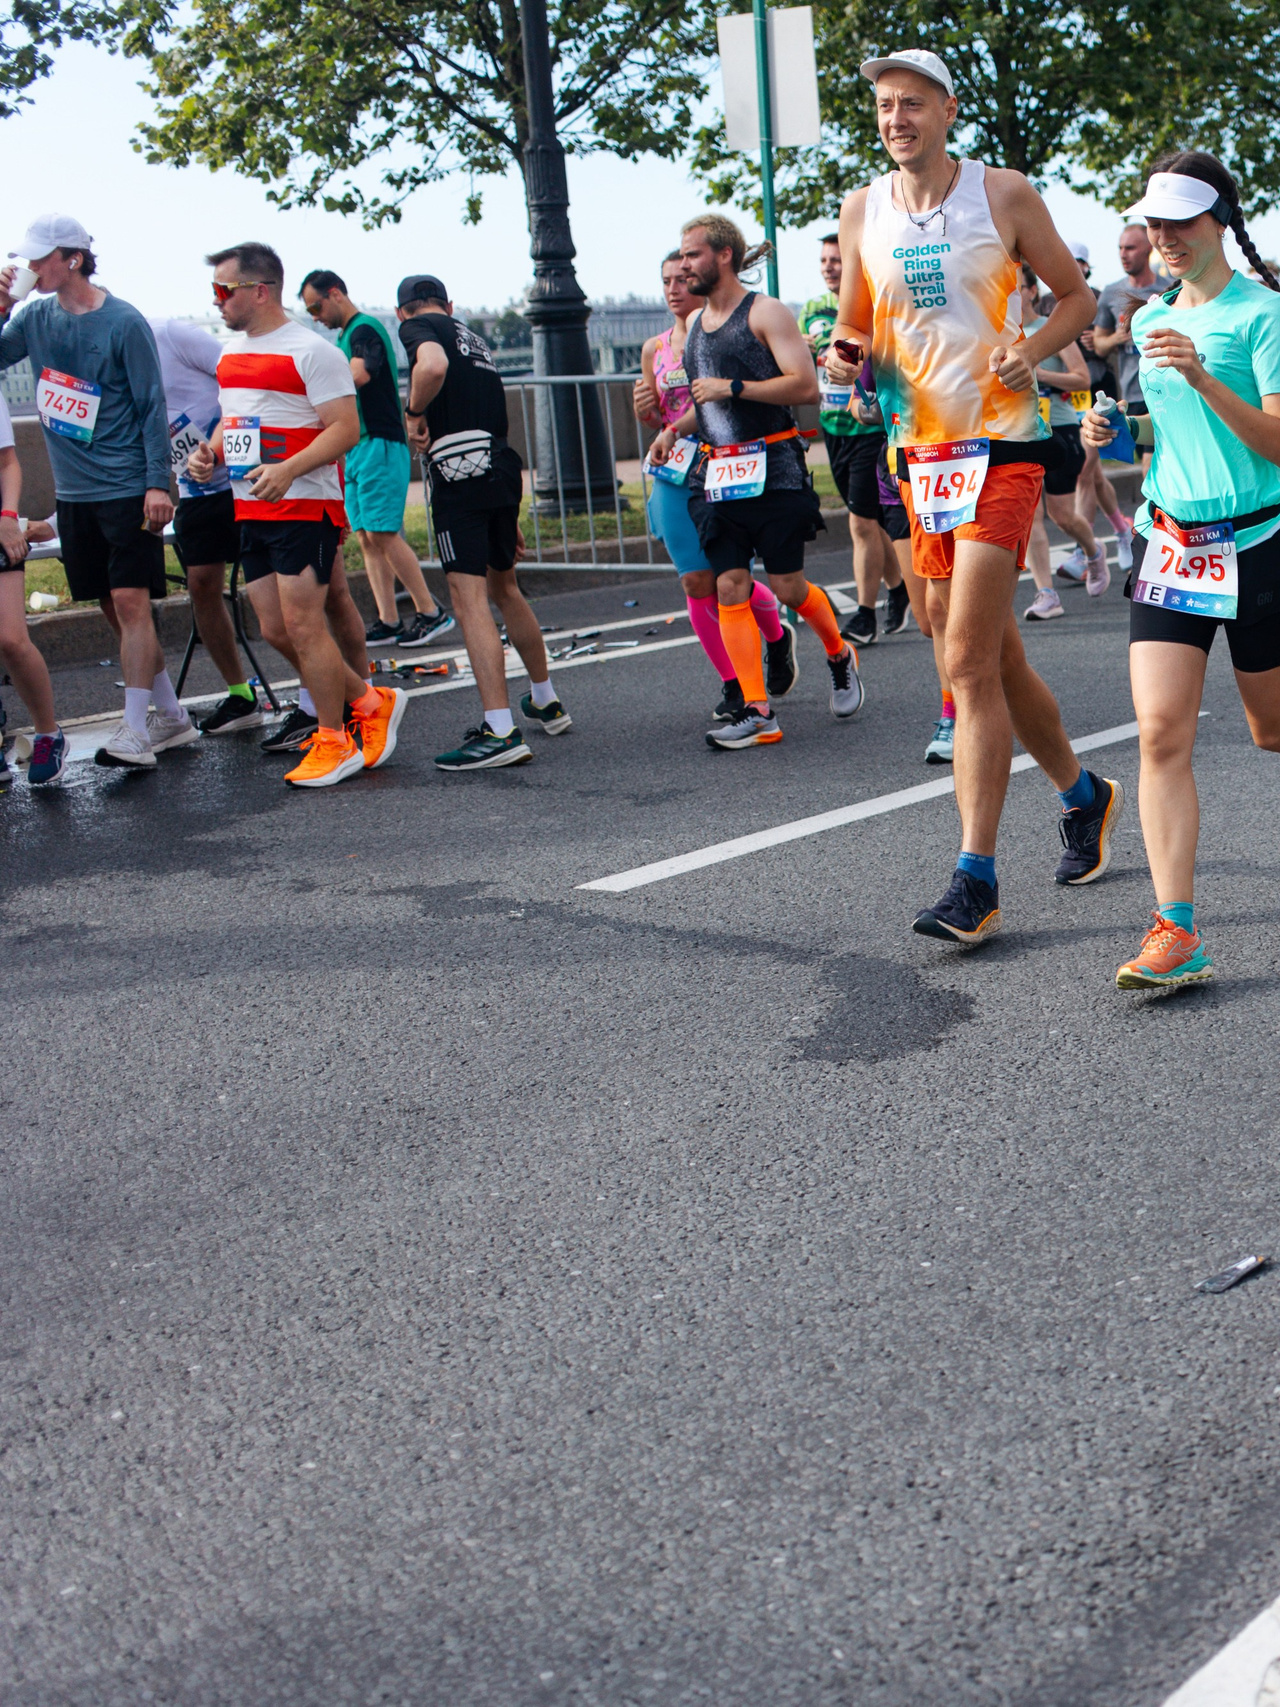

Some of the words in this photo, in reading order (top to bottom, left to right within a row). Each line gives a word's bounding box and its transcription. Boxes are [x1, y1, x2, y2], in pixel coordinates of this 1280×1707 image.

[893, 243, 951, 259] Golden
[904, 258, 941, 271] Ring
[904, 271, 945, 284] Ultra
[908, 282, 945, 296] Trail
[913, 296, 947, 309] 100
[44, 390, 90, 419] 7475
[951, 446, 966, 455] 21,1
[716, 460, 758, 482] 7157
[919, 470, 977, 502] 7494
[713, 489, 720, 500] E
[924, 517, 931, 530] E
[1189, 535, 1205, 543] 21,1
[1160, 544, 1226, 582] 7495
[1149, 586, 1162, 602] E
